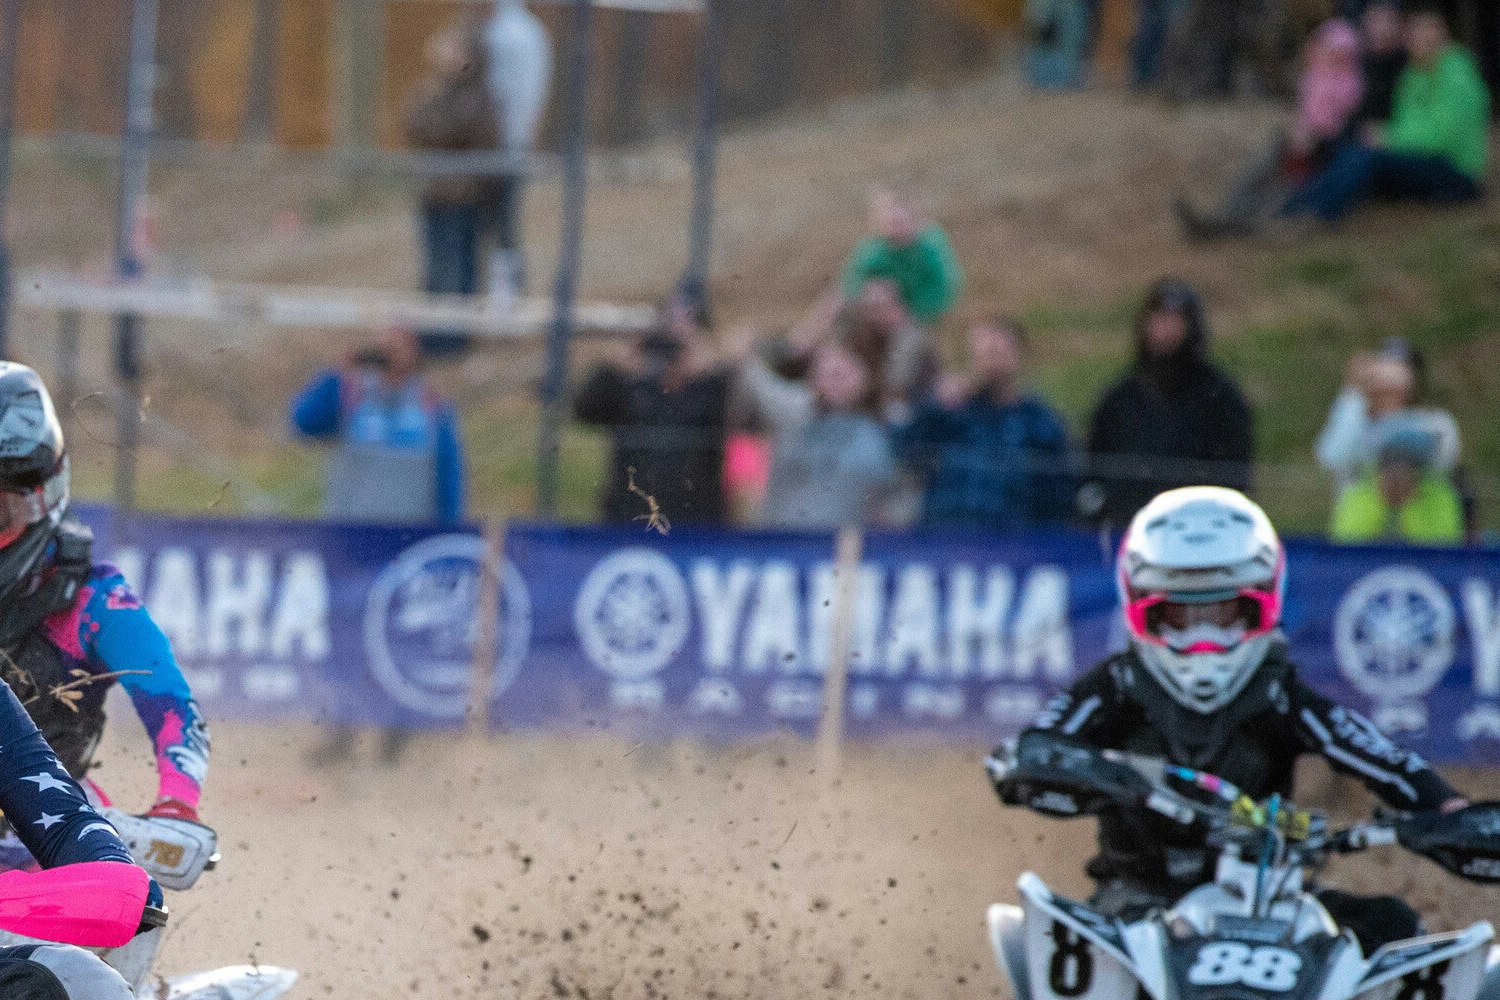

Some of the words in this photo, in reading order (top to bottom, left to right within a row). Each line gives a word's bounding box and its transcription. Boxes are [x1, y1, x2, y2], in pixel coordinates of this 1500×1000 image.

[112, 548, 329, 660] AHA
[691, 558, 1074, 677] YAMAHA
[1188, 941, 1302, 992] 88
